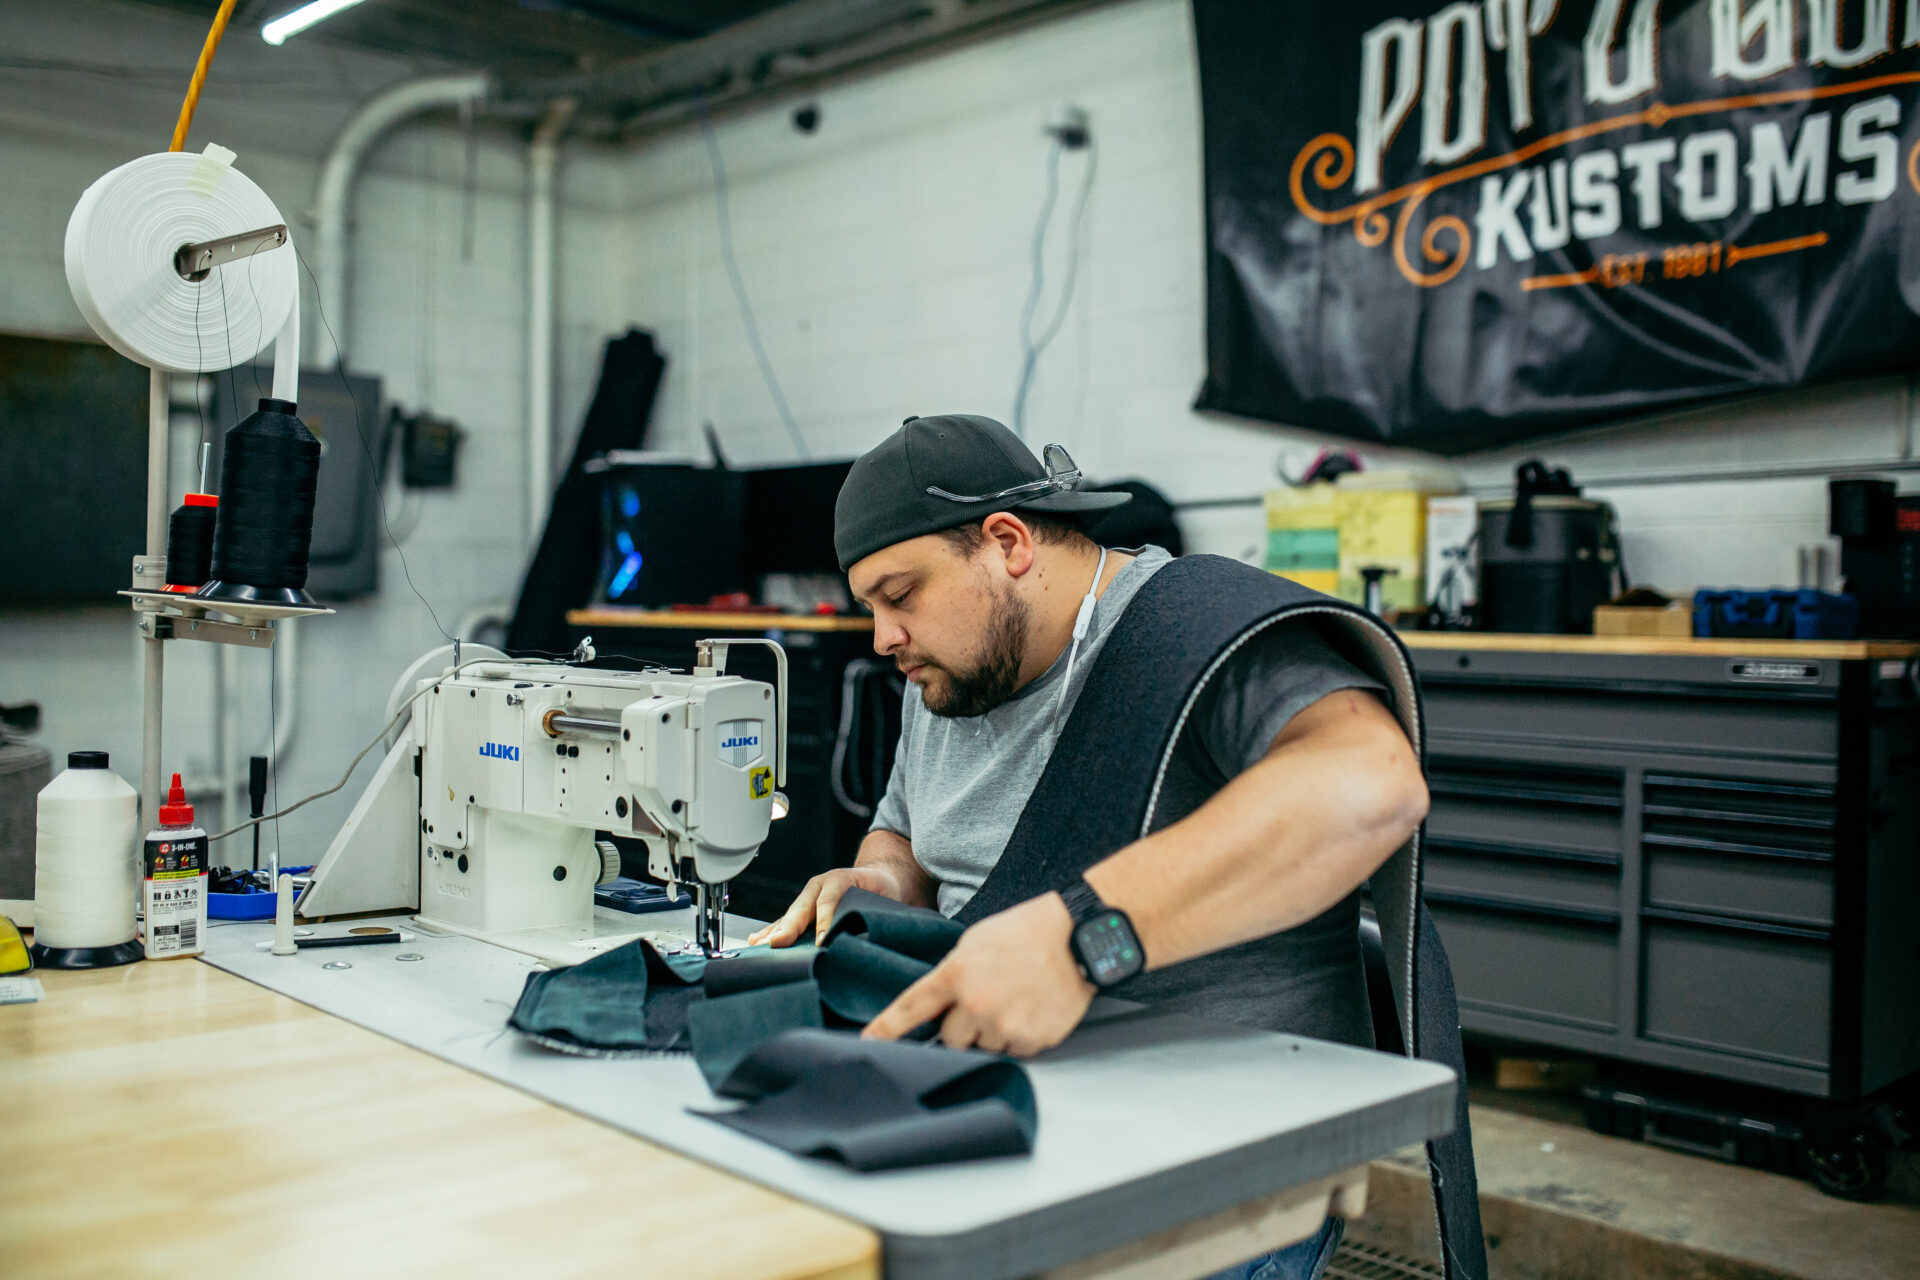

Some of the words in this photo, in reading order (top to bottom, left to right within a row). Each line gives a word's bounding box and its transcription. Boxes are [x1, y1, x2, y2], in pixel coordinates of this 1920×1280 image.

[1476, 95, 1899, 270] KUSTOMS
[479, 742, 519, 762] JUKI
[721, 736, 758, 748] JUKI
